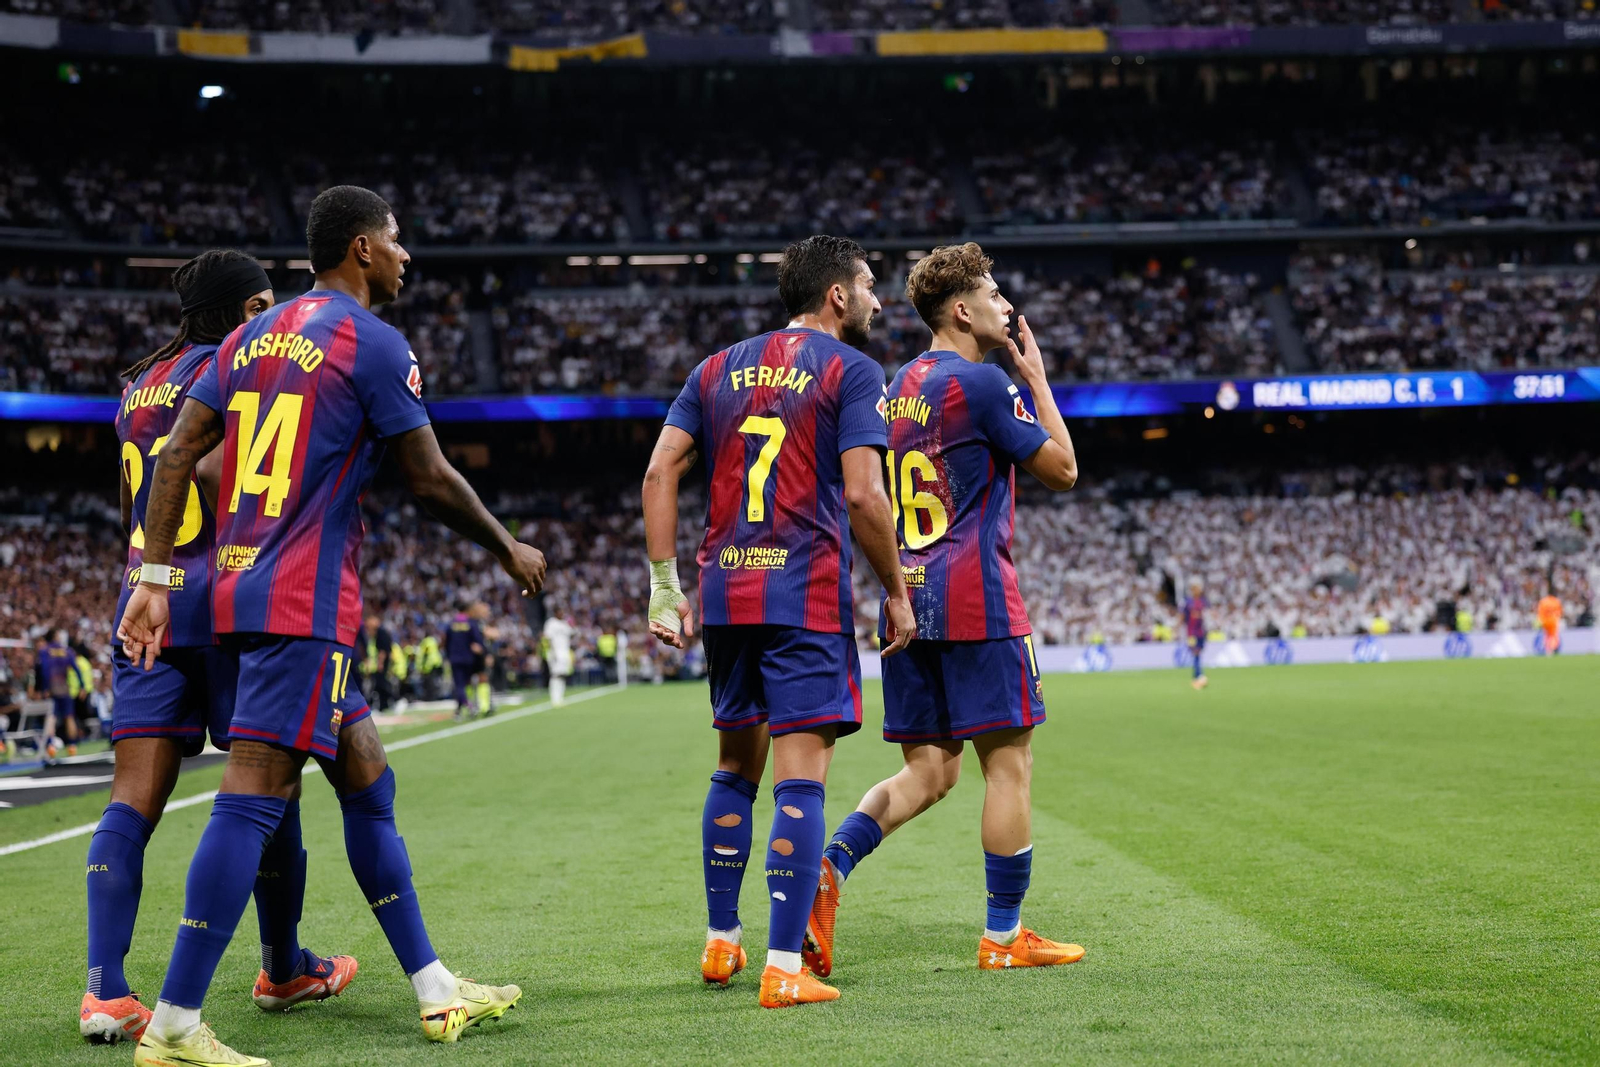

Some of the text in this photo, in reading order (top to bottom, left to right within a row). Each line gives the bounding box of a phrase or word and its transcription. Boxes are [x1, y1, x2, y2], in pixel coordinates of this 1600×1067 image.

[233, 332, 324, 374] RASHFORD
[730, 365, 813, 395] FERRAN
[1253, 381, 1307, 406] REAL
[1309, 378, 1392, 405] MADRID
[1449, 377, 1464, 401] 1
[885, 394, 931, 427] FERMÍN
[227, 390, 304, 518] 14
[737, 415, 787, 523] 7
[744, 556, 786, 566] ACNUR
[746, 546, 788, 557] UNHCR
[710, 859, 743, 868] BARÇA
